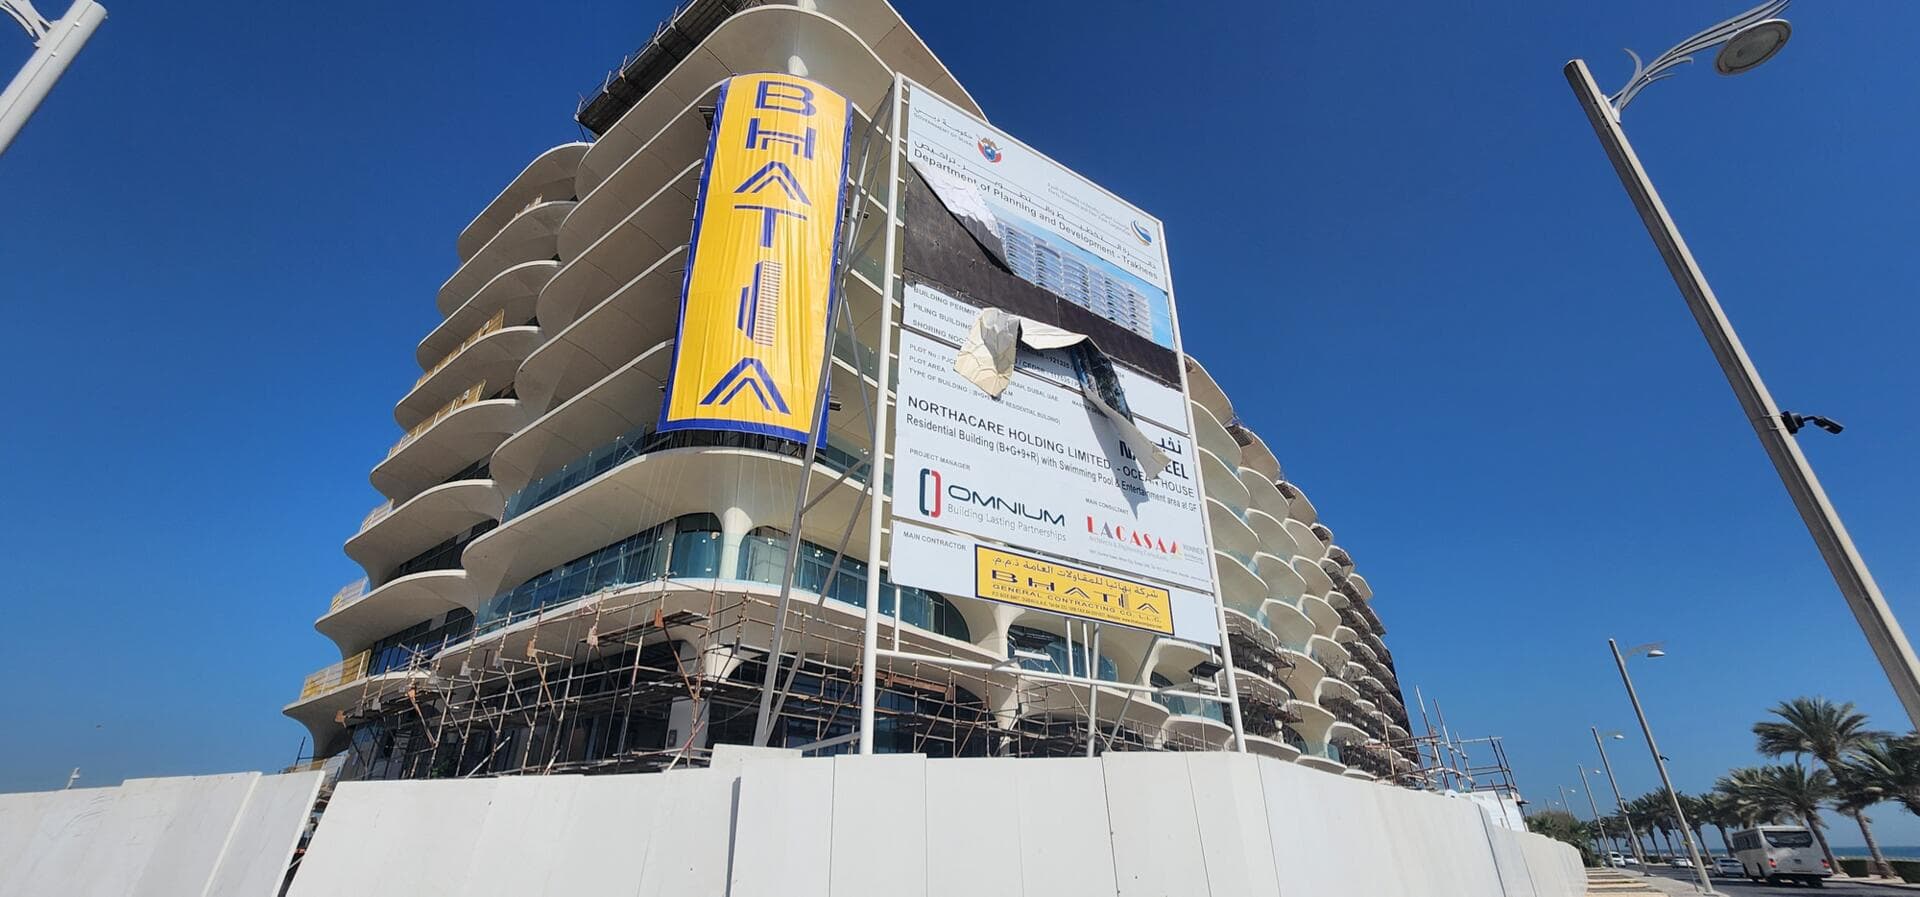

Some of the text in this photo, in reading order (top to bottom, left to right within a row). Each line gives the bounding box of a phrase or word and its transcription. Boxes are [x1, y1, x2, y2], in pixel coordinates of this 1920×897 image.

[914, 148, 977, 184] Department
[980, 182, 991, 194] of
[993, 187, 1037, 218] Planning
[1039, 211, 1056, 226] and
[1059, 221, 1116, 259] Development
[699, 80, 816, 415] BHATIA
[913, 287, 976, 316] BUILDING PERMIT
[913, 303, 937, 317] PILING
[913, 320, 947, 337] SHORING
[909, 344, 926, 353] PLOT
[909, 355, 946, 373] PLOT AREA
[909, 367, 926, 378] TYPE
[938, 378, 968, 392] BUILDING
[908, 396, 1005, 436] NORTHACARE
[1009, 428, 1064, 454] HOLDING
[1067, 446, 1111, 470] LIMITED
[1122, 465, 1159, 486] OCE
[1162, 481, 1195, 498] HOUSE
[910, 448, 971, 471] PROJECT MANAGER
[907, 413, 956, 438] Residential
[959, 429, 994, 452] Building
[997, 441, 1040, 465] (B+G+9+R)
[1041, 455, 1057, 468] with
[1059, 460, 1097, 483] Swimming
[1097, 473, 1114, 487] Pool
[1122, 480, 1166, 502] Entertainment
[1167, 497, 1181, 508] area
[948, 484, 1065, 527] OMNIUM
[1085, 498, 1129, 515] MAIN CONSULTANT
[948, 503, 1067, 542] Building Lasting Partnerships
[903, 531, 968, 551] MAIN CONTRACTOR
[1023, 561, 1054, 574] العامة
[992, 569, 1159, 614] BHATIA
[992, 584, 1041, 598] GENERAL
[1047, 594, 1116, 613] CONTRACTING
[1135, 587, 1159, 599] شركة
